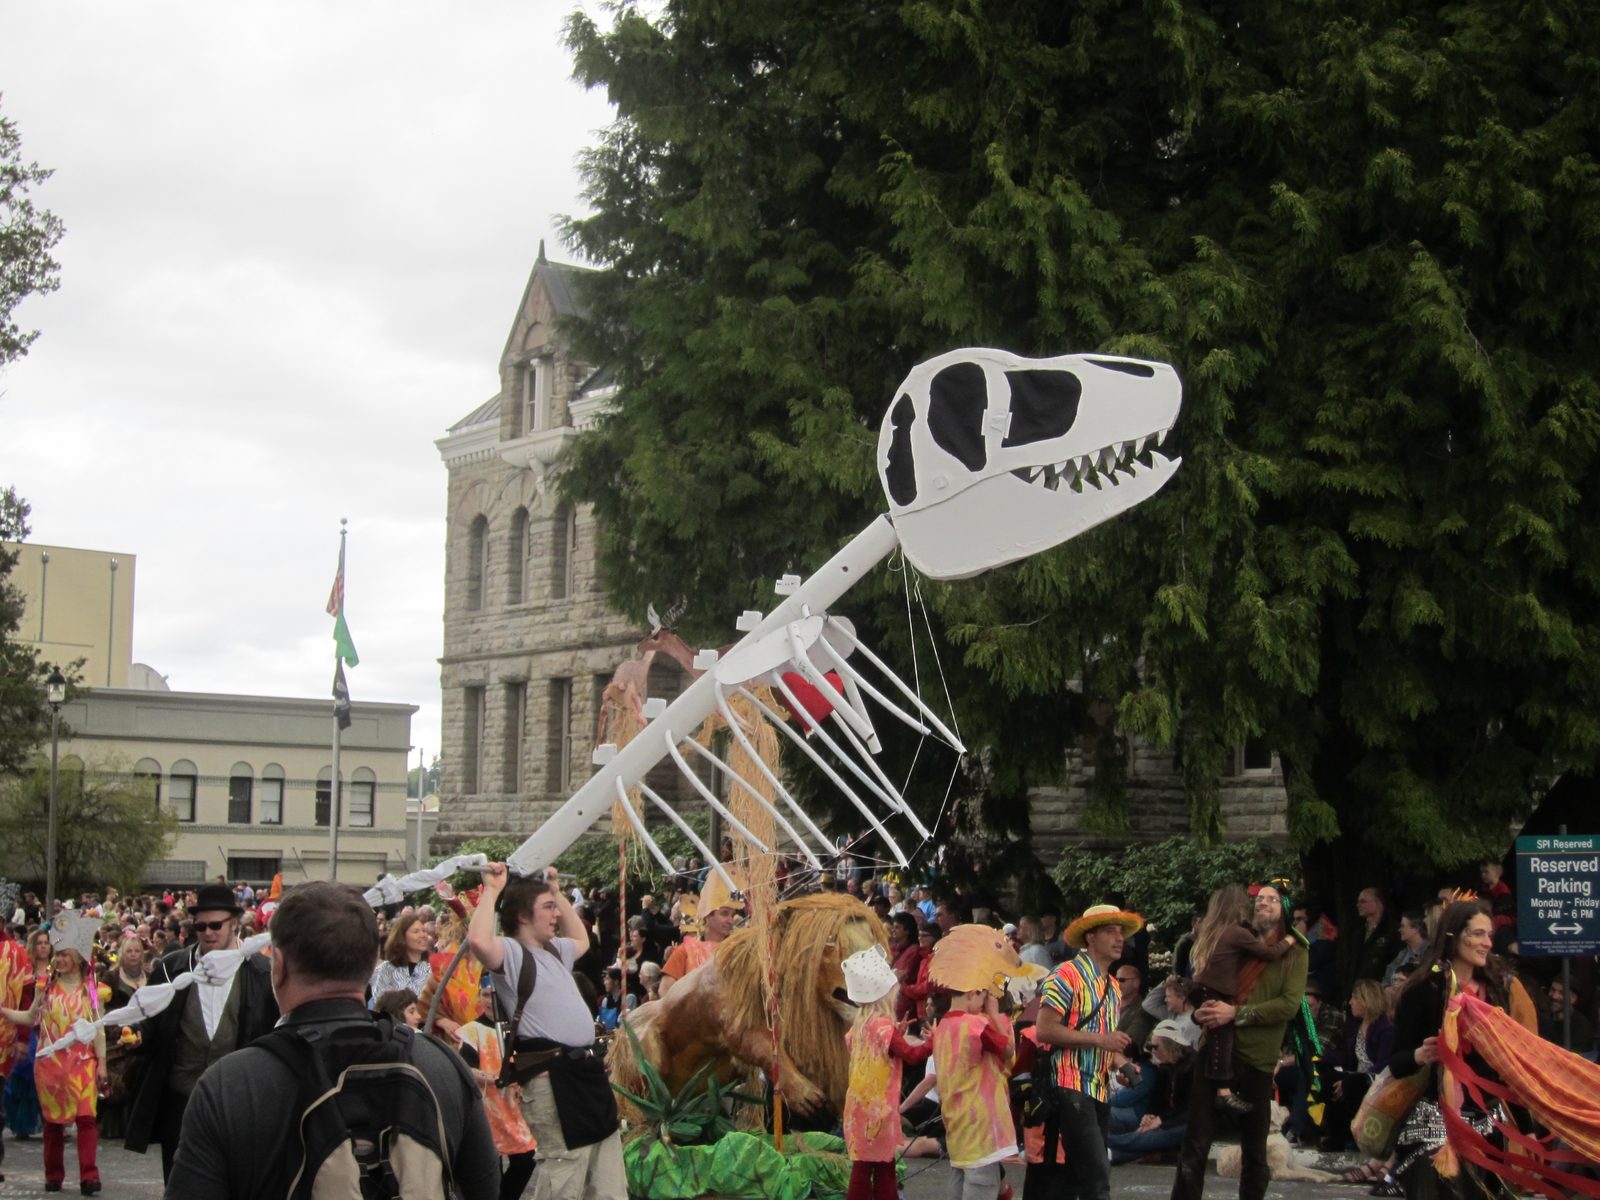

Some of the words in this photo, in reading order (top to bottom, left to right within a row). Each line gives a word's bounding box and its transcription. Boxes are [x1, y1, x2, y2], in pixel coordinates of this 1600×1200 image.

[1537, 840, 1550, 849] SPI
[1553, 839, 1592, 848] Reserved
[1530, 857, 1598, 872] Reserved
[1538, 878, 1591, 896] Parking
[1531, 898, 1563, 908] Monday
[1574, 898, 1600, 908] Friday
[1538, 910, 1544, 919] 6
[1547, 910, 1560, 918] AM
[1571, 910, 1577, 919] 6
[1580, 910, 1593, 918] PM
